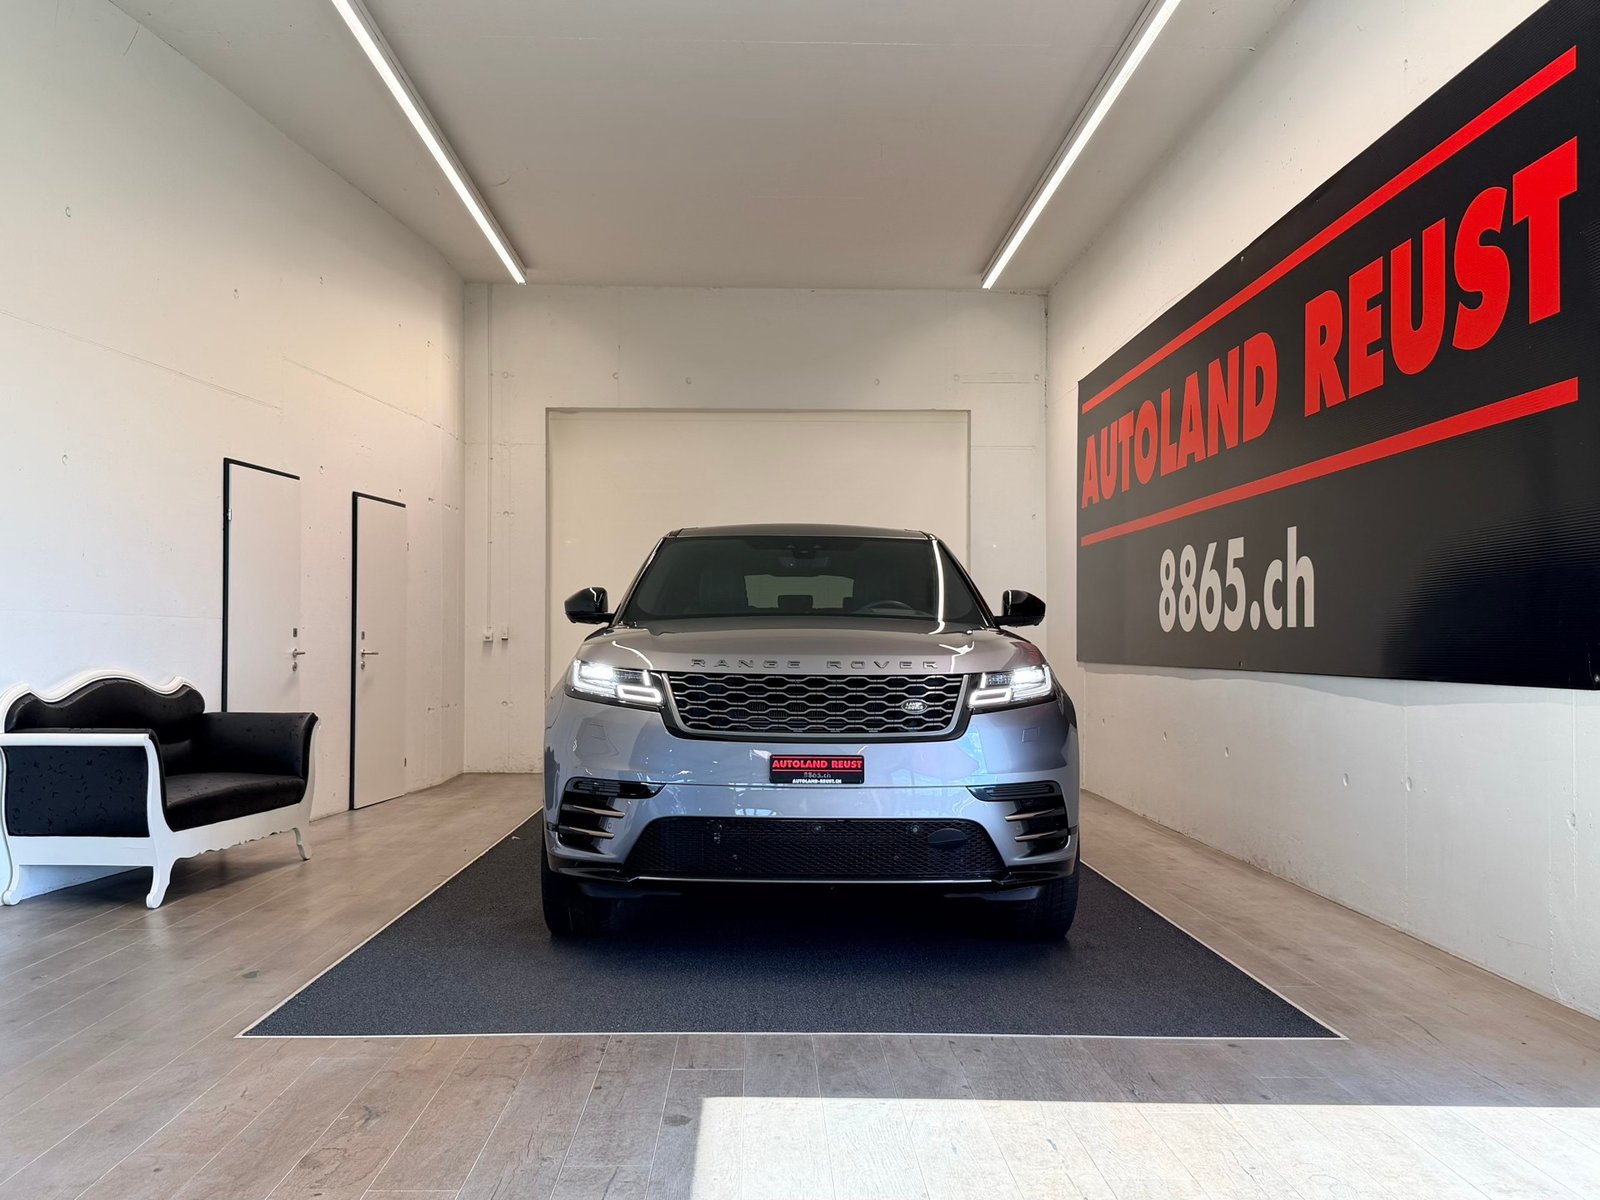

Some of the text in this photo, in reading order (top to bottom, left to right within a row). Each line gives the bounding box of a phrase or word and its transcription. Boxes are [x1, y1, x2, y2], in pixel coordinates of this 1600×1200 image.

[1081, 136, 1577, 509] AUTOLAND REUST
[1158, 526, 1315, 633] 8865.ch
[690, 658, 938, 670] RANGE ROVER
[772, 760, 862, 768] AUTOLAND REUST
